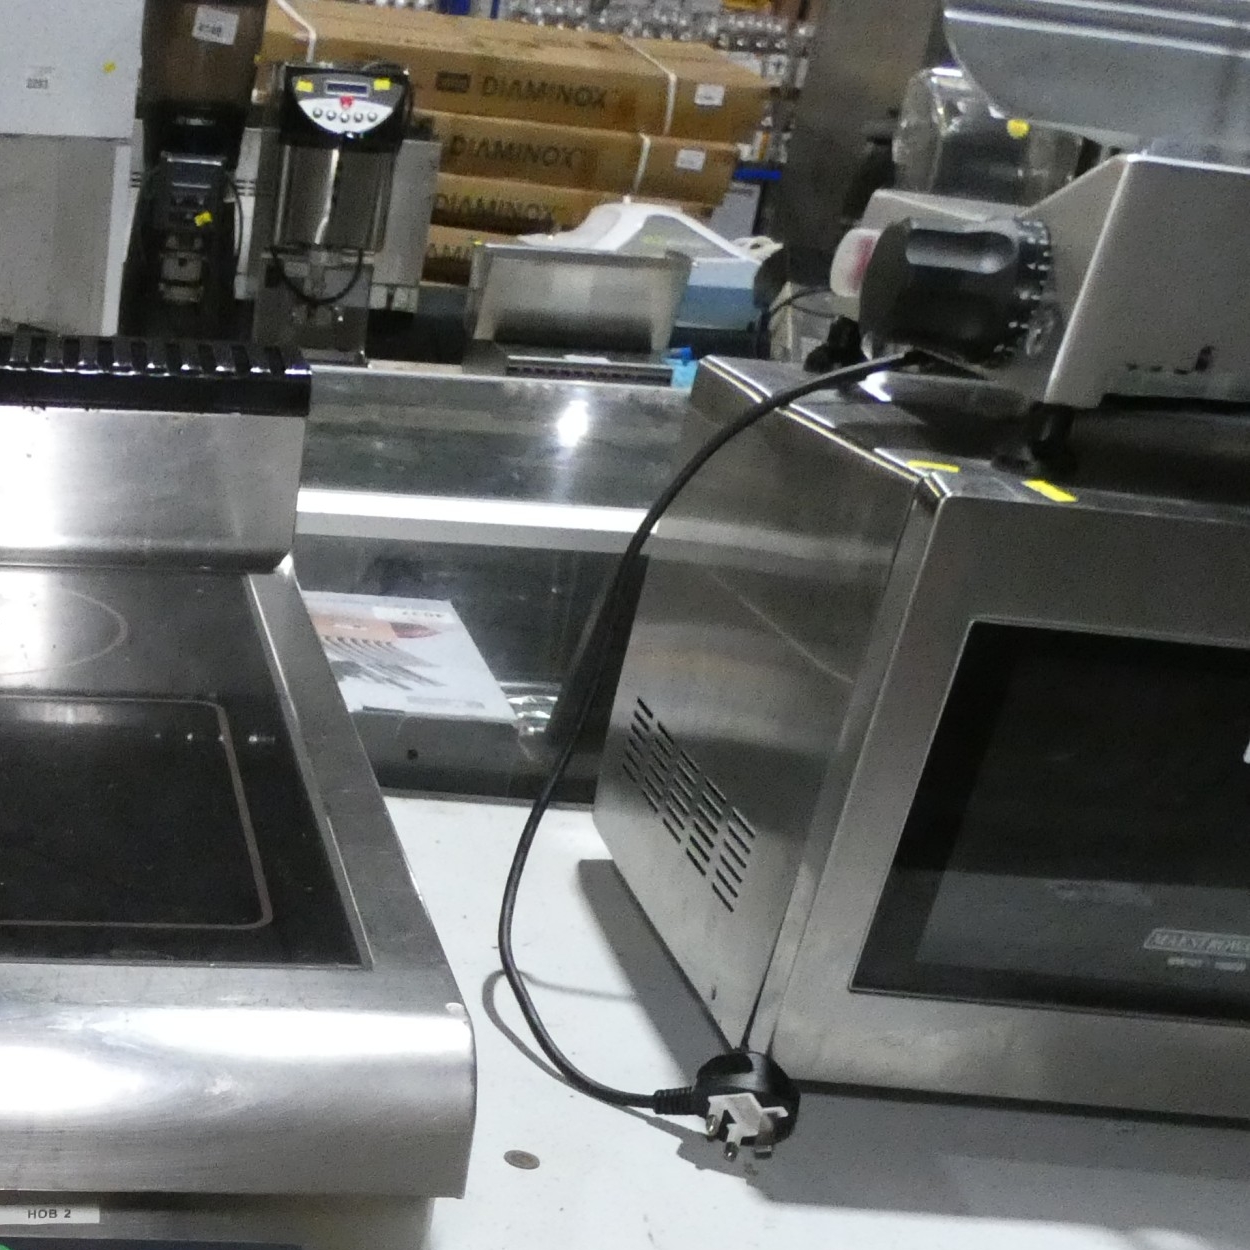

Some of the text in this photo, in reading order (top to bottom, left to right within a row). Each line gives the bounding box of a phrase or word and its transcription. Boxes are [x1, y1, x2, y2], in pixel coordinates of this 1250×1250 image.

[483, 75, 607, 108] DIAMINOX
[27, 1208, 72, 1220] HOB 2
